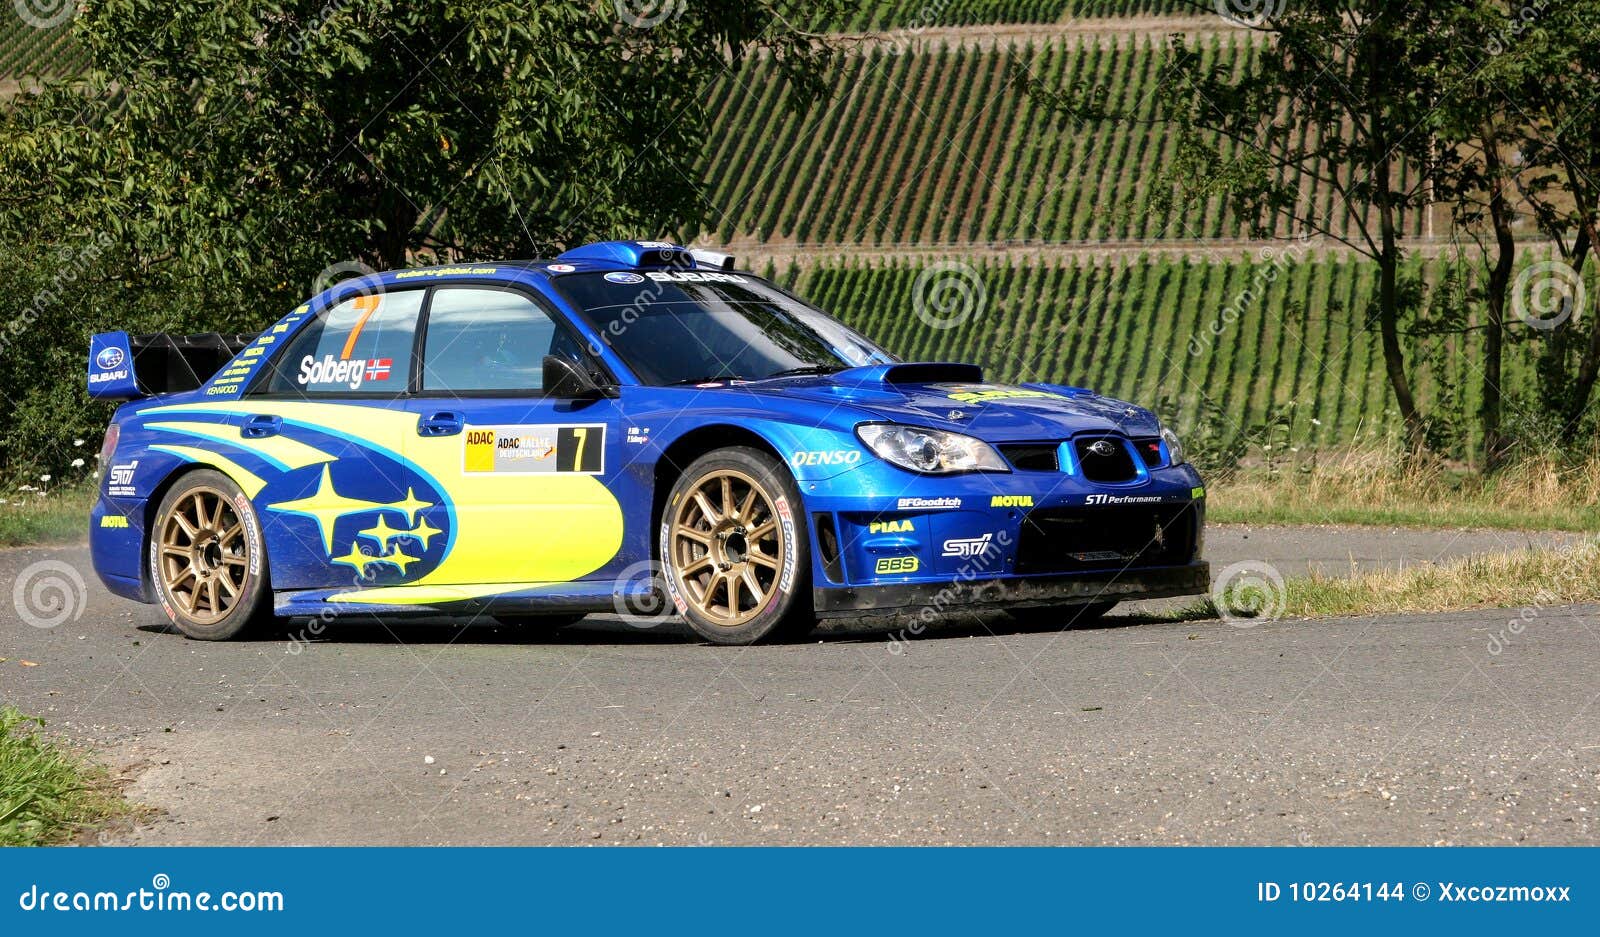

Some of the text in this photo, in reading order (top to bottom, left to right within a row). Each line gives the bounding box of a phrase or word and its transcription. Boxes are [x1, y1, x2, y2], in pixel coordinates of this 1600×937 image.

[396, 267, 497, 279] subaru-global.com
[645, 271, 748, 284] SUBARU
[341, 296, 382, 360] 7
[90, 370, 128, 383] SUBARU
[298, 354, 366, 390] Solberg
[206, 385, 238, 395] KENWOOD
[466, 431, 494, 445] ADAC
[498, 437, 520, 449] ADAC
[573, 428, 587, 472] 7
[791, 450, 861, 467] DENSO
[897, 497, 962, 509] BFGoodrich
[991, 495, 1034, 508] MOTUL
[1084, 494, 1162, 505] STI Performance
[101, 516, 129, 528] MOTUL
[869, 519, 915, 534] PIAA
[774, 495, 799, 594] BFGoodrich
[877, 557, 915, 571] BBS
